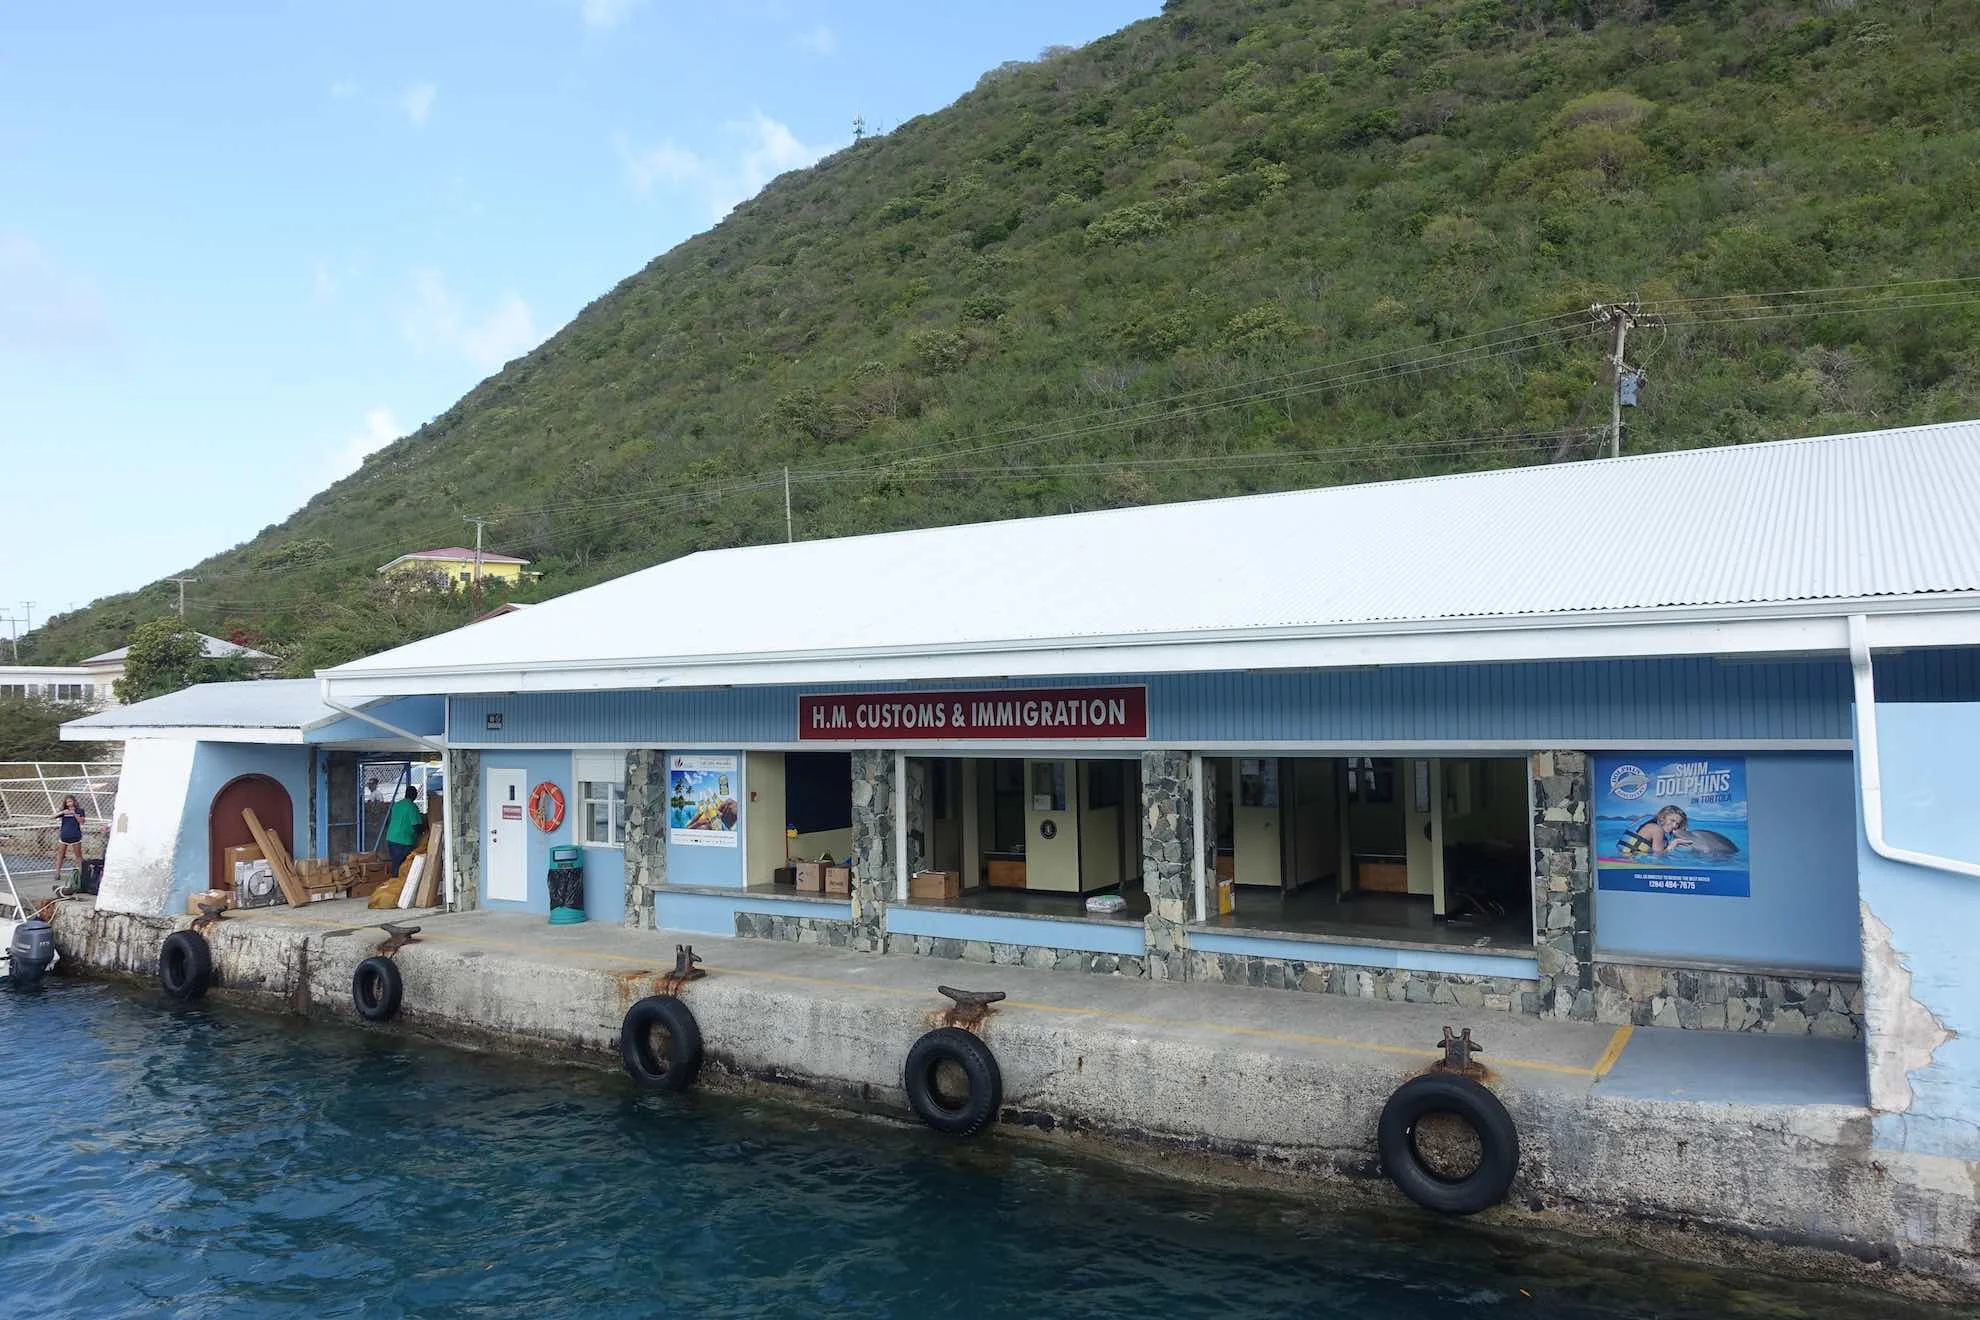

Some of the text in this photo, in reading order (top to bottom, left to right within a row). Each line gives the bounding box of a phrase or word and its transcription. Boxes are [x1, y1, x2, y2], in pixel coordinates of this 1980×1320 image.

[813, 698, 1126, 729] H.M. CUSTOMS & IMMIGRATION
[1676, 761, 1709, 777] SWIM
[1655, 773, 1731, 797] DOLPHINS
[1701, 794, 1732, 804] TORTOLA
